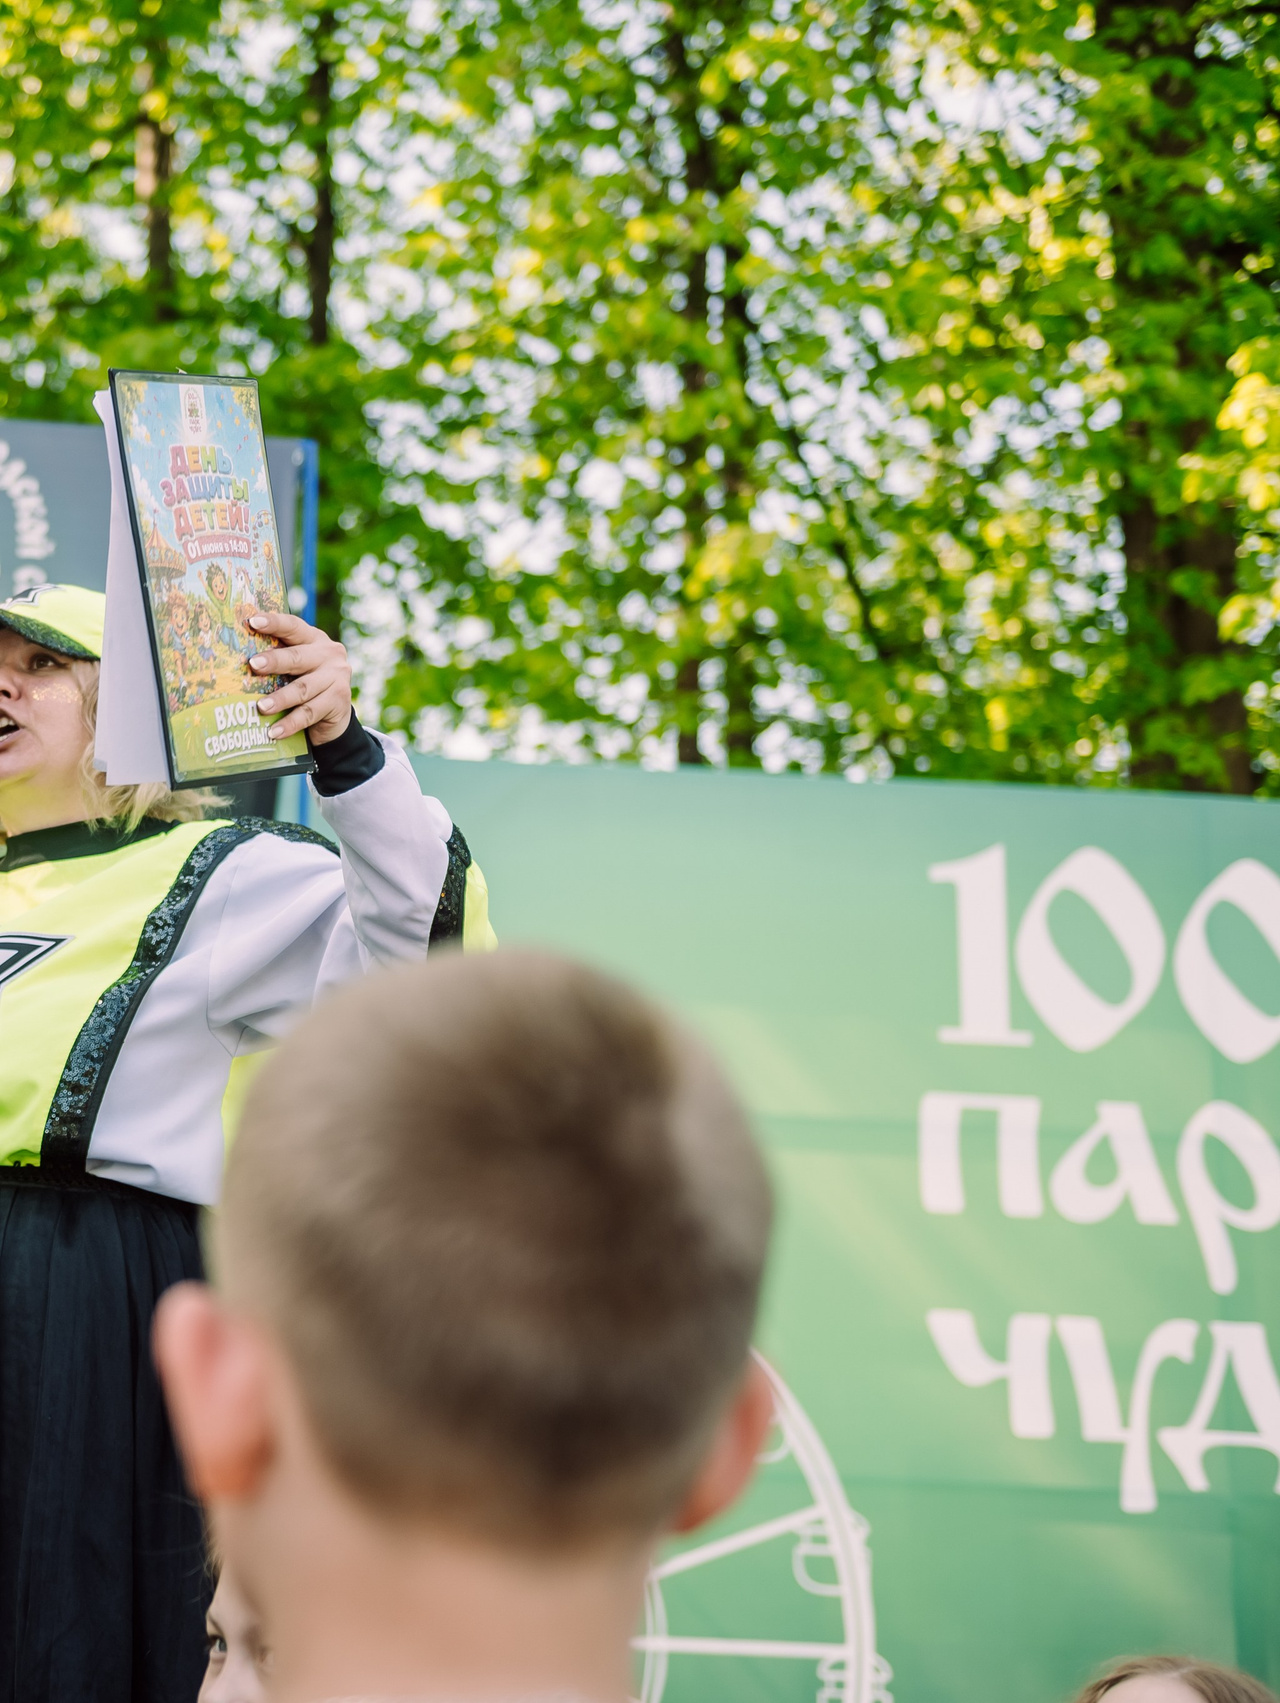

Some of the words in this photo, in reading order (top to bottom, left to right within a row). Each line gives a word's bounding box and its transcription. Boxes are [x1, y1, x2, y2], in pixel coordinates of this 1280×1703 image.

[170, 445, 232, 480] ДЕНЬ
[160, 475, 249, 508] ЗАЩИТЫ
[173, 500, 250, 541] ДЕТЕЙ!
[187, 540, 202, 559] 01
[215, 701, 261, 732] ВХОД
[927, 843, 1280, 1064] 100
